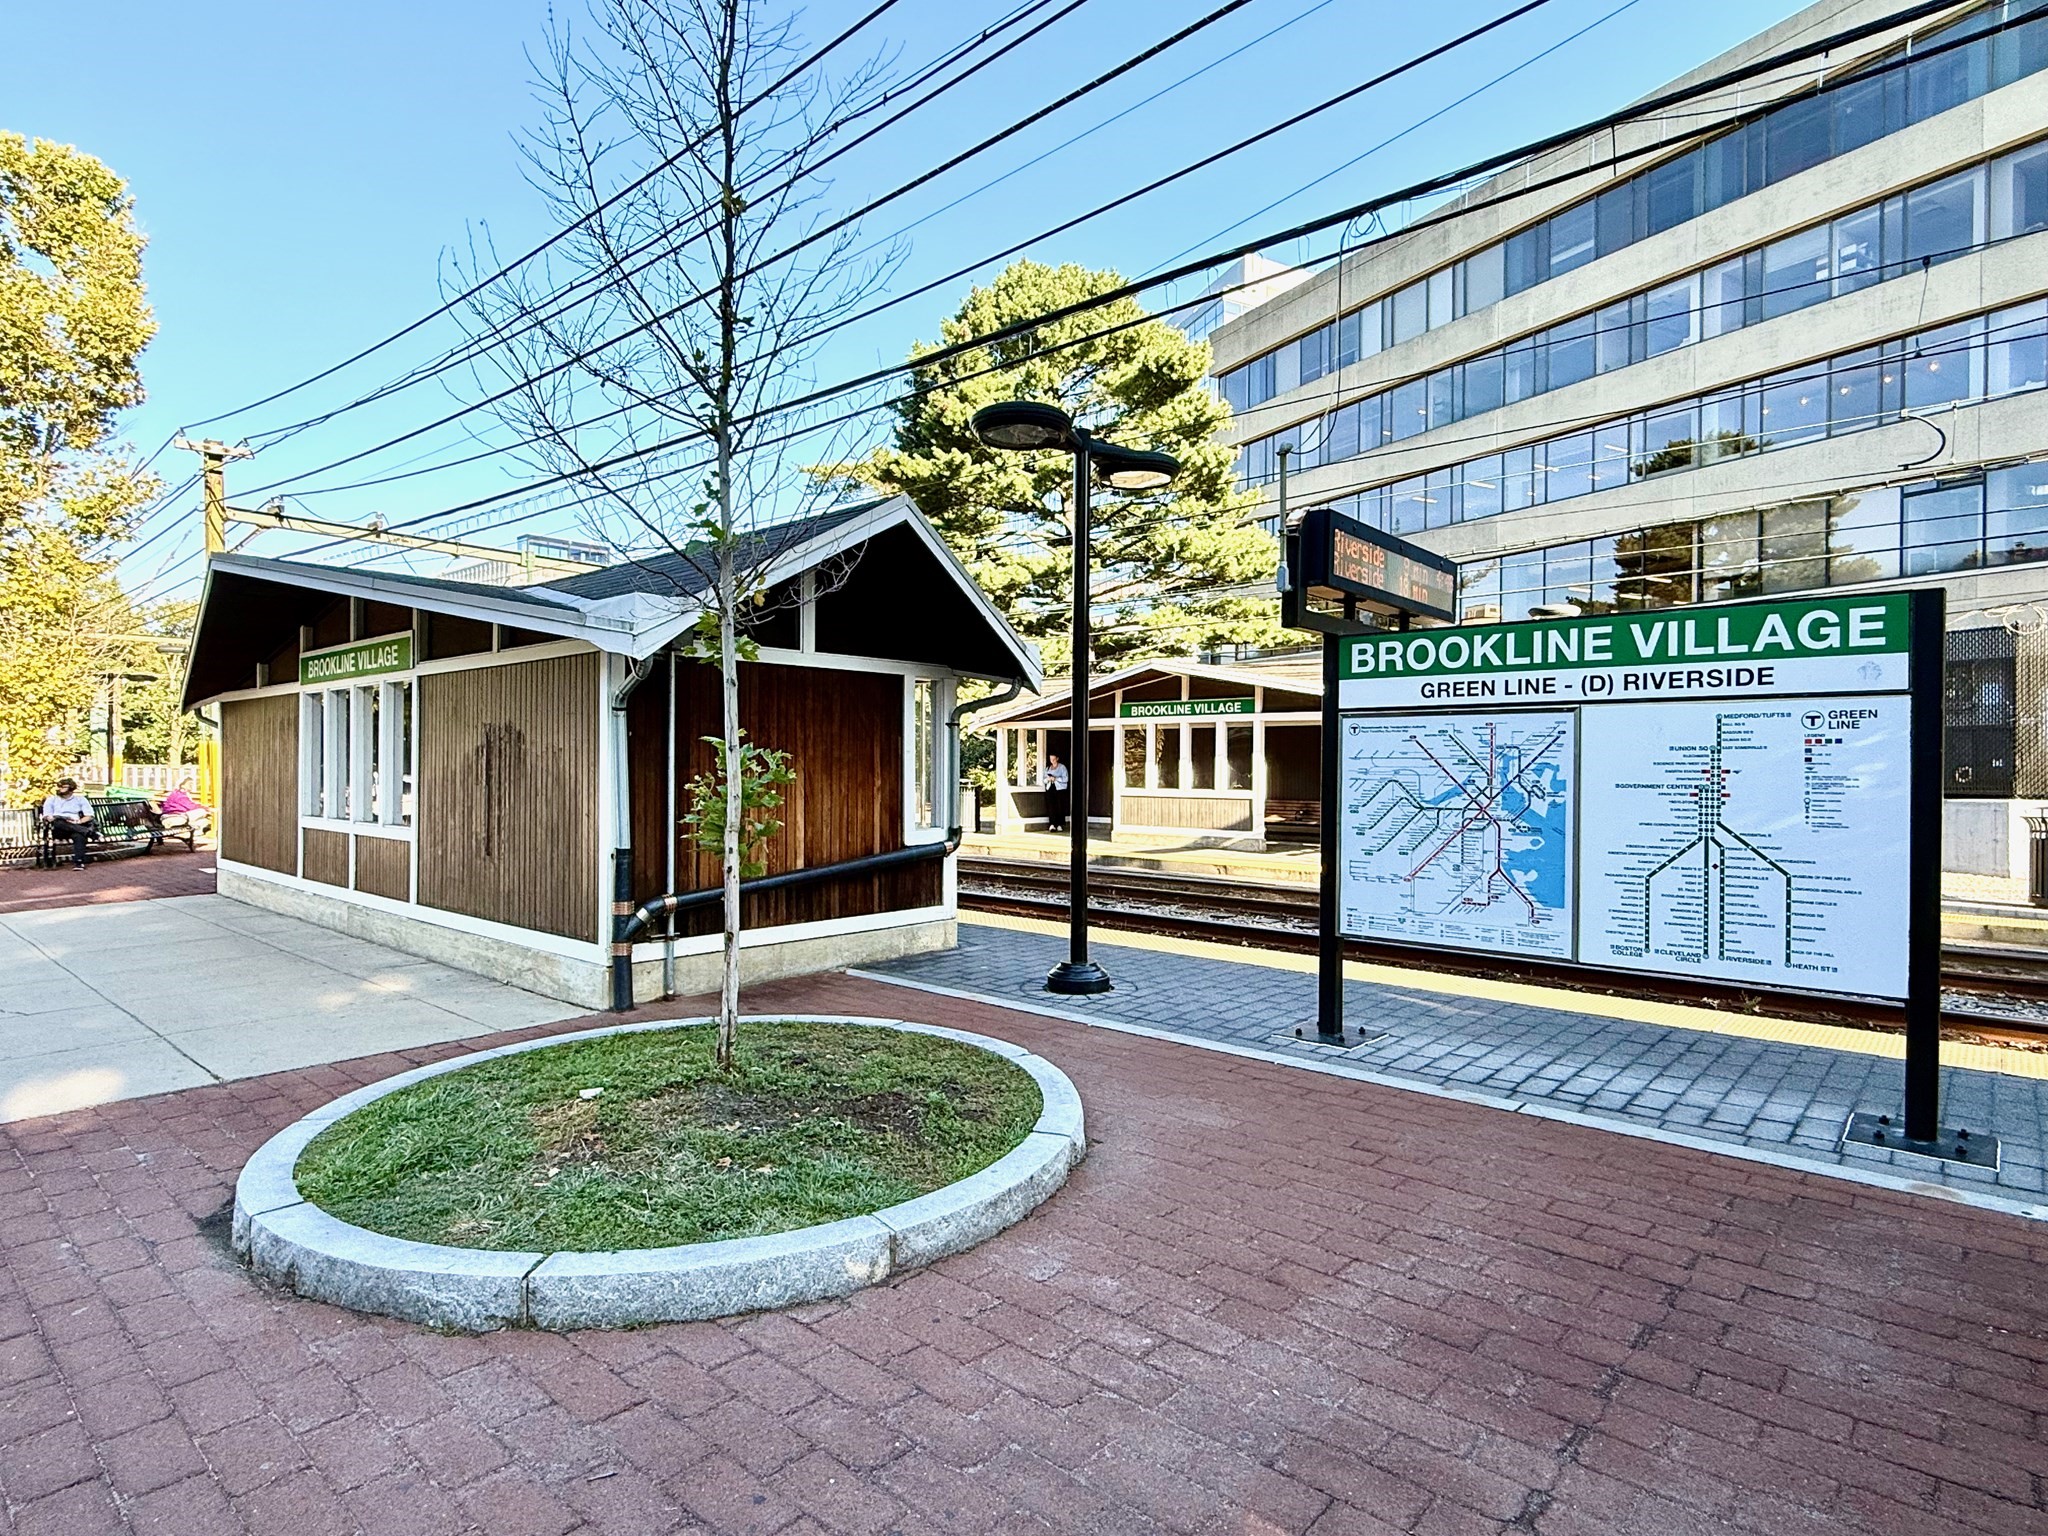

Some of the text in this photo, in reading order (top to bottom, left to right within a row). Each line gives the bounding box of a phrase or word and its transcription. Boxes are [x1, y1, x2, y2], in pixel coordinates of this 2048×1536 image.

[1334, 528, 1385, 568] Riverside
[1333, 551, 1384, 588] Riverside
[1350, 606, 1887, 675] BROOKLINE VILLAGE
[308, 645, 399, 678] BROOKLINE VILLAGE
[1420, 678, 1496, 699] GREEN
[1503, 676, 1556, 697] LINE
[1580, 672, 1615, 698] (D)
[1623, 666, 1776, 692] RIVERSIDE
[1131, 702, 1241, 716] BROOKLINE VILLAGE
[1828, 709, 1878, 719] GREEN
[1828, 720, 1861, 729] LINE
[1615, 944, 1643, 952] BOSTON
[1612, 950, 1643, 958] COLLEGE
[1660, 949, 1702, 958] CLEVELAND
[1675, 956, 1702, 964] CIRCLE
[1726, 956, 1765, 965] RIVERSIDE
[1792, 963, 1831, 973] HEATH ST
